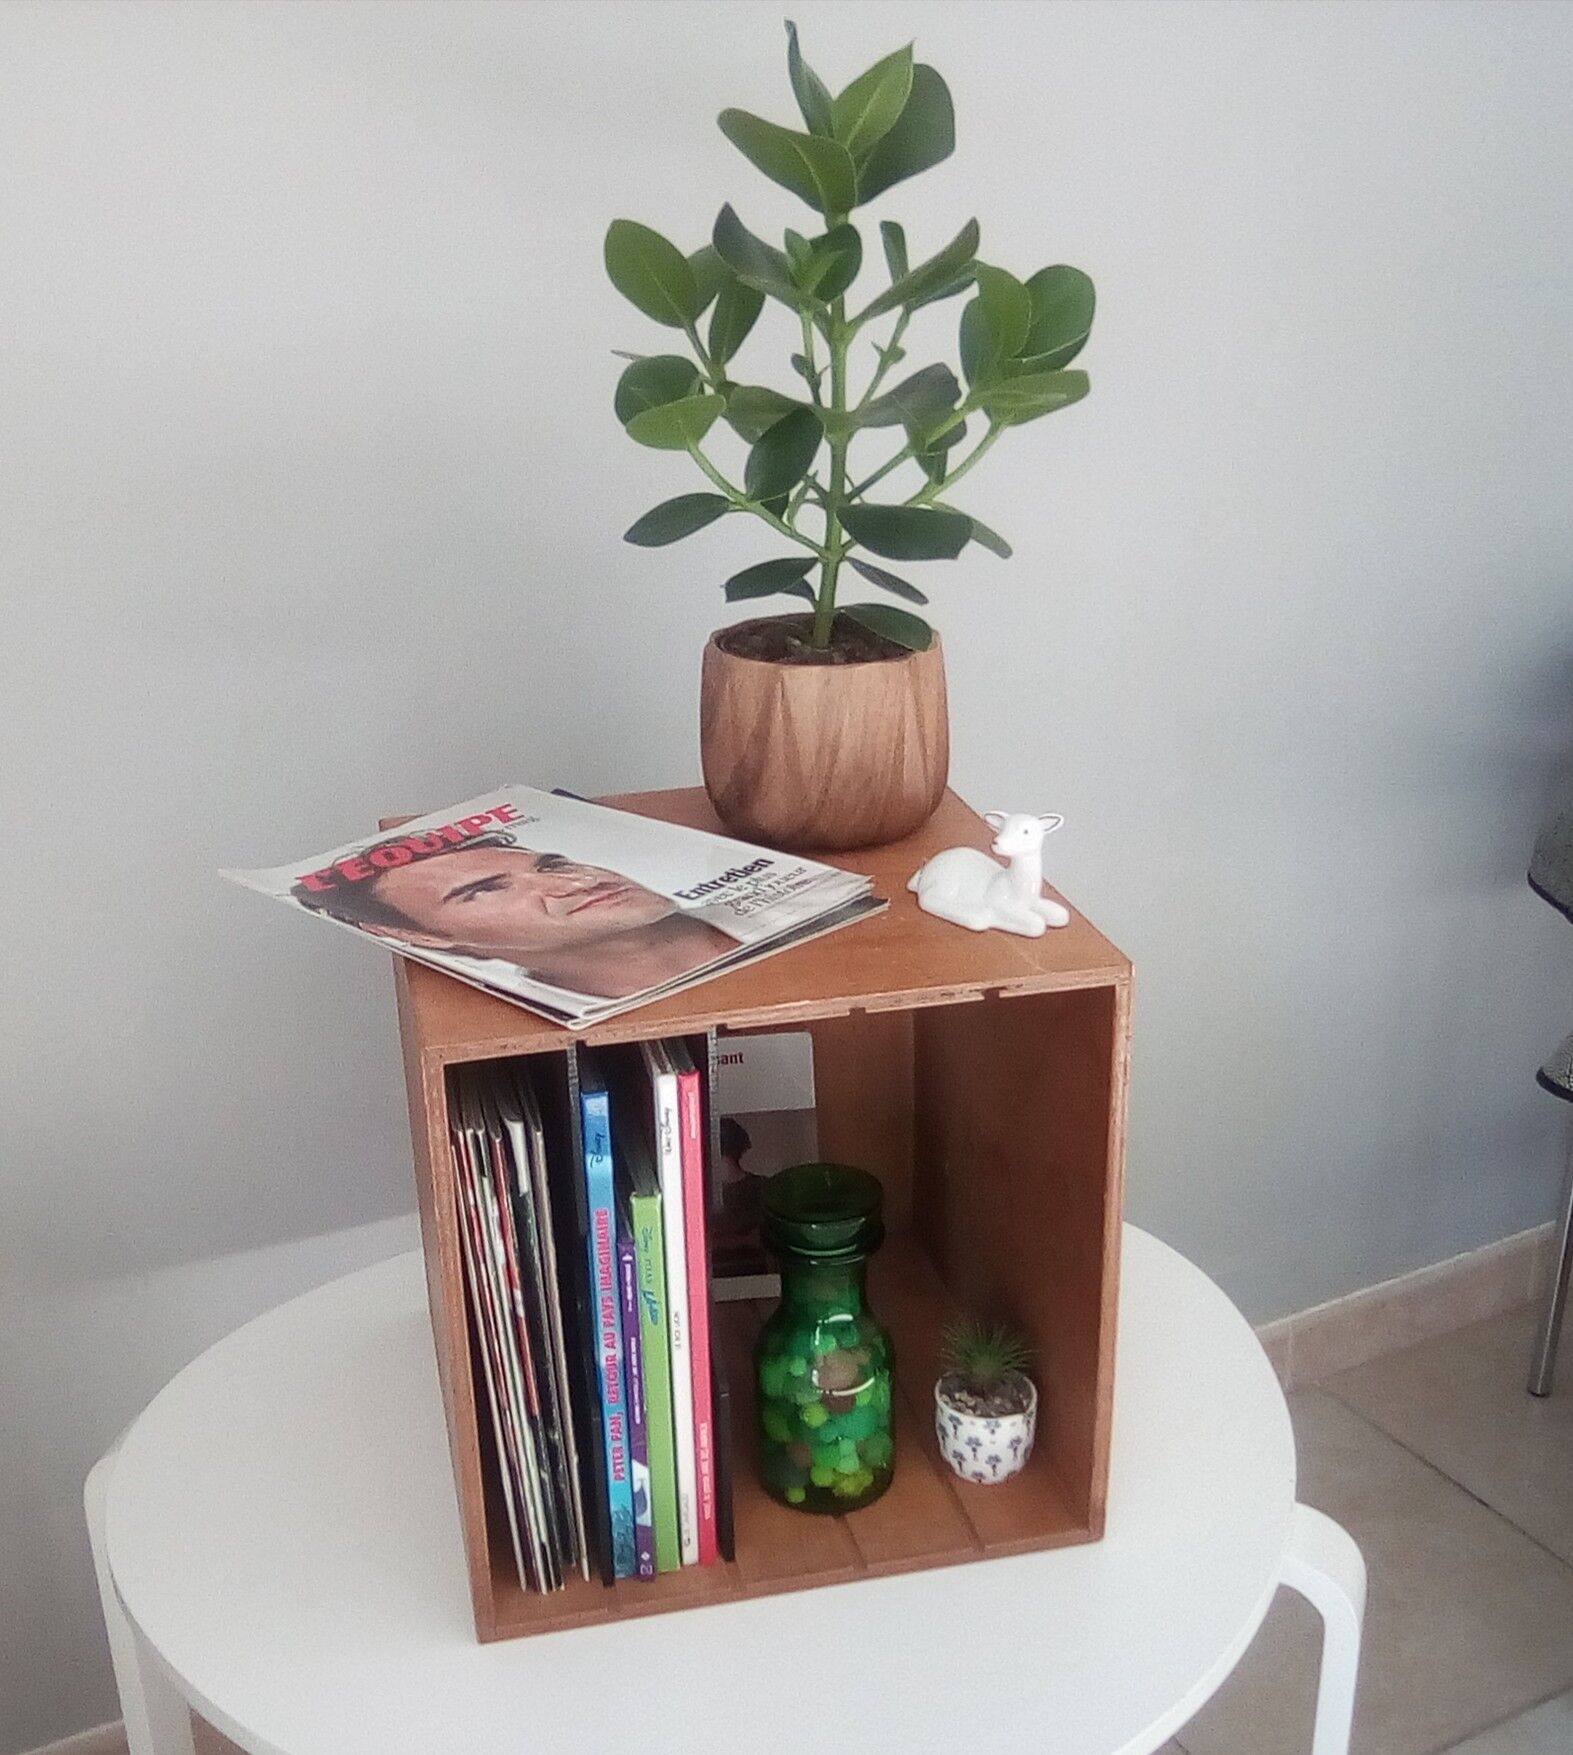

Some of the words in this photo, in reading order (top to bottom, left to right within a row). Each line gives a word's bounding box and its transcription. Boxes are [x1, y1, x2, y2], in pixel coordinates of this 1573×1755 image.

[673, 858, 775, 900] Entretien
[596, 1209, 612, 1291] IMAGINAIRE
[601, 1296, 615, 1328] PAYS
[603, 1331, 617, 1350] AU
[605, 1354, 620, 1404] RETOUR
[612, 1446, 625, 1481] PETER
